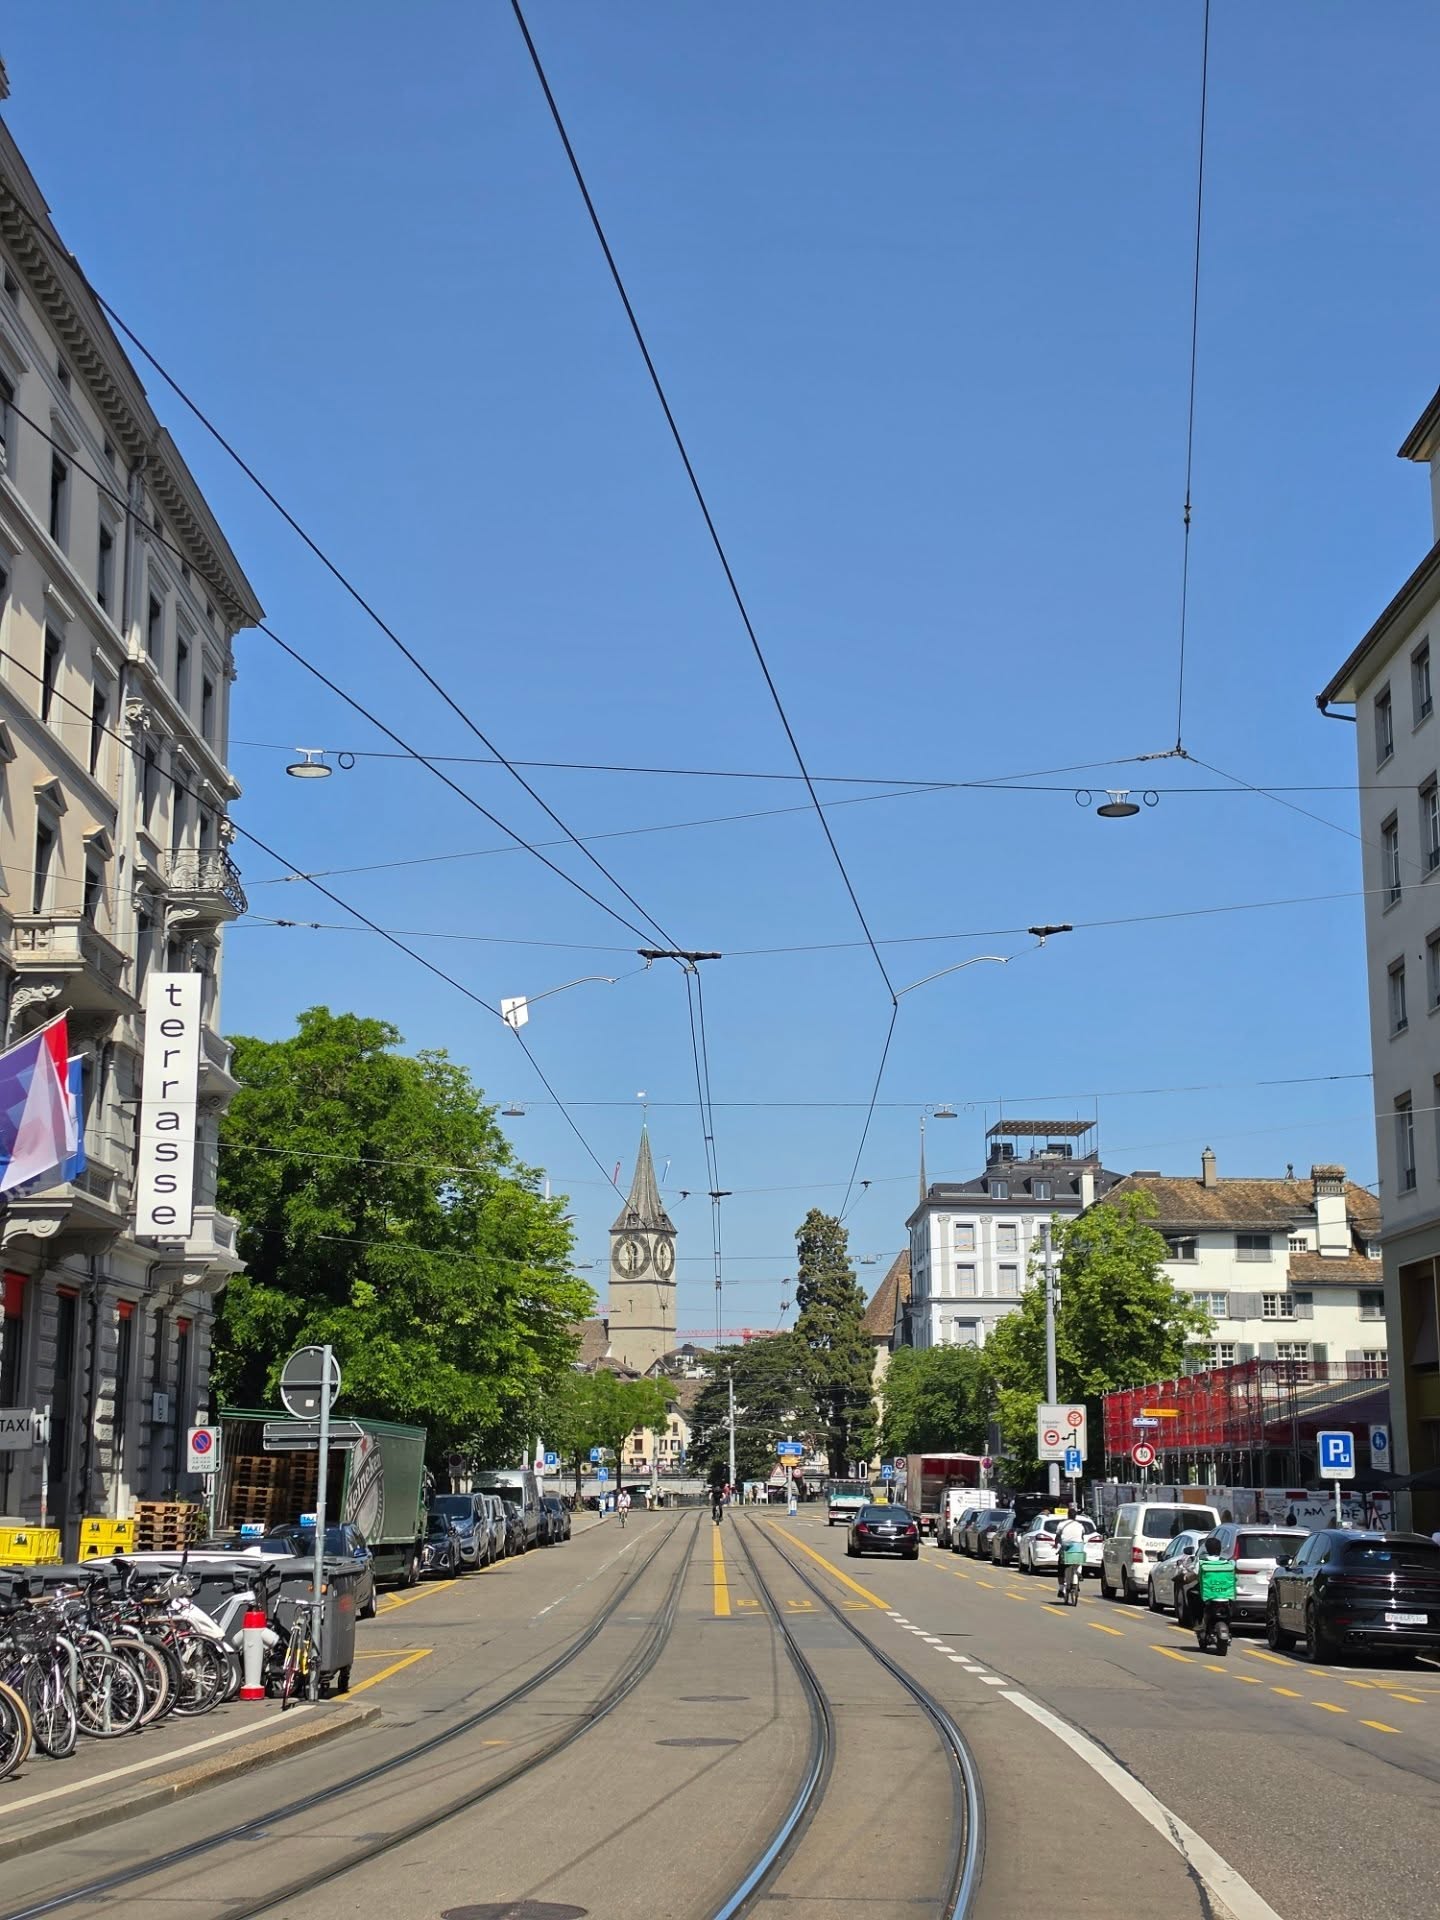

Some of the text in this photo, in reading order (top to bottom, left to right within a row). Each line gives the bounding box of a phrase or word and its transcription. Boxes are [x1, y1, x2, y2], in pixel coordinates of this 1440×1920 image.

[151, 983, 185, 1225] terrasse
[0, 1418, 30, 1432] TAXI
[1070, 1451, 1077, 1461] P
[1329, 1439, 1343, 1461] P
[547, 1455, 553, 1464] P
[1304, 1507, 1325, 1516] AM
